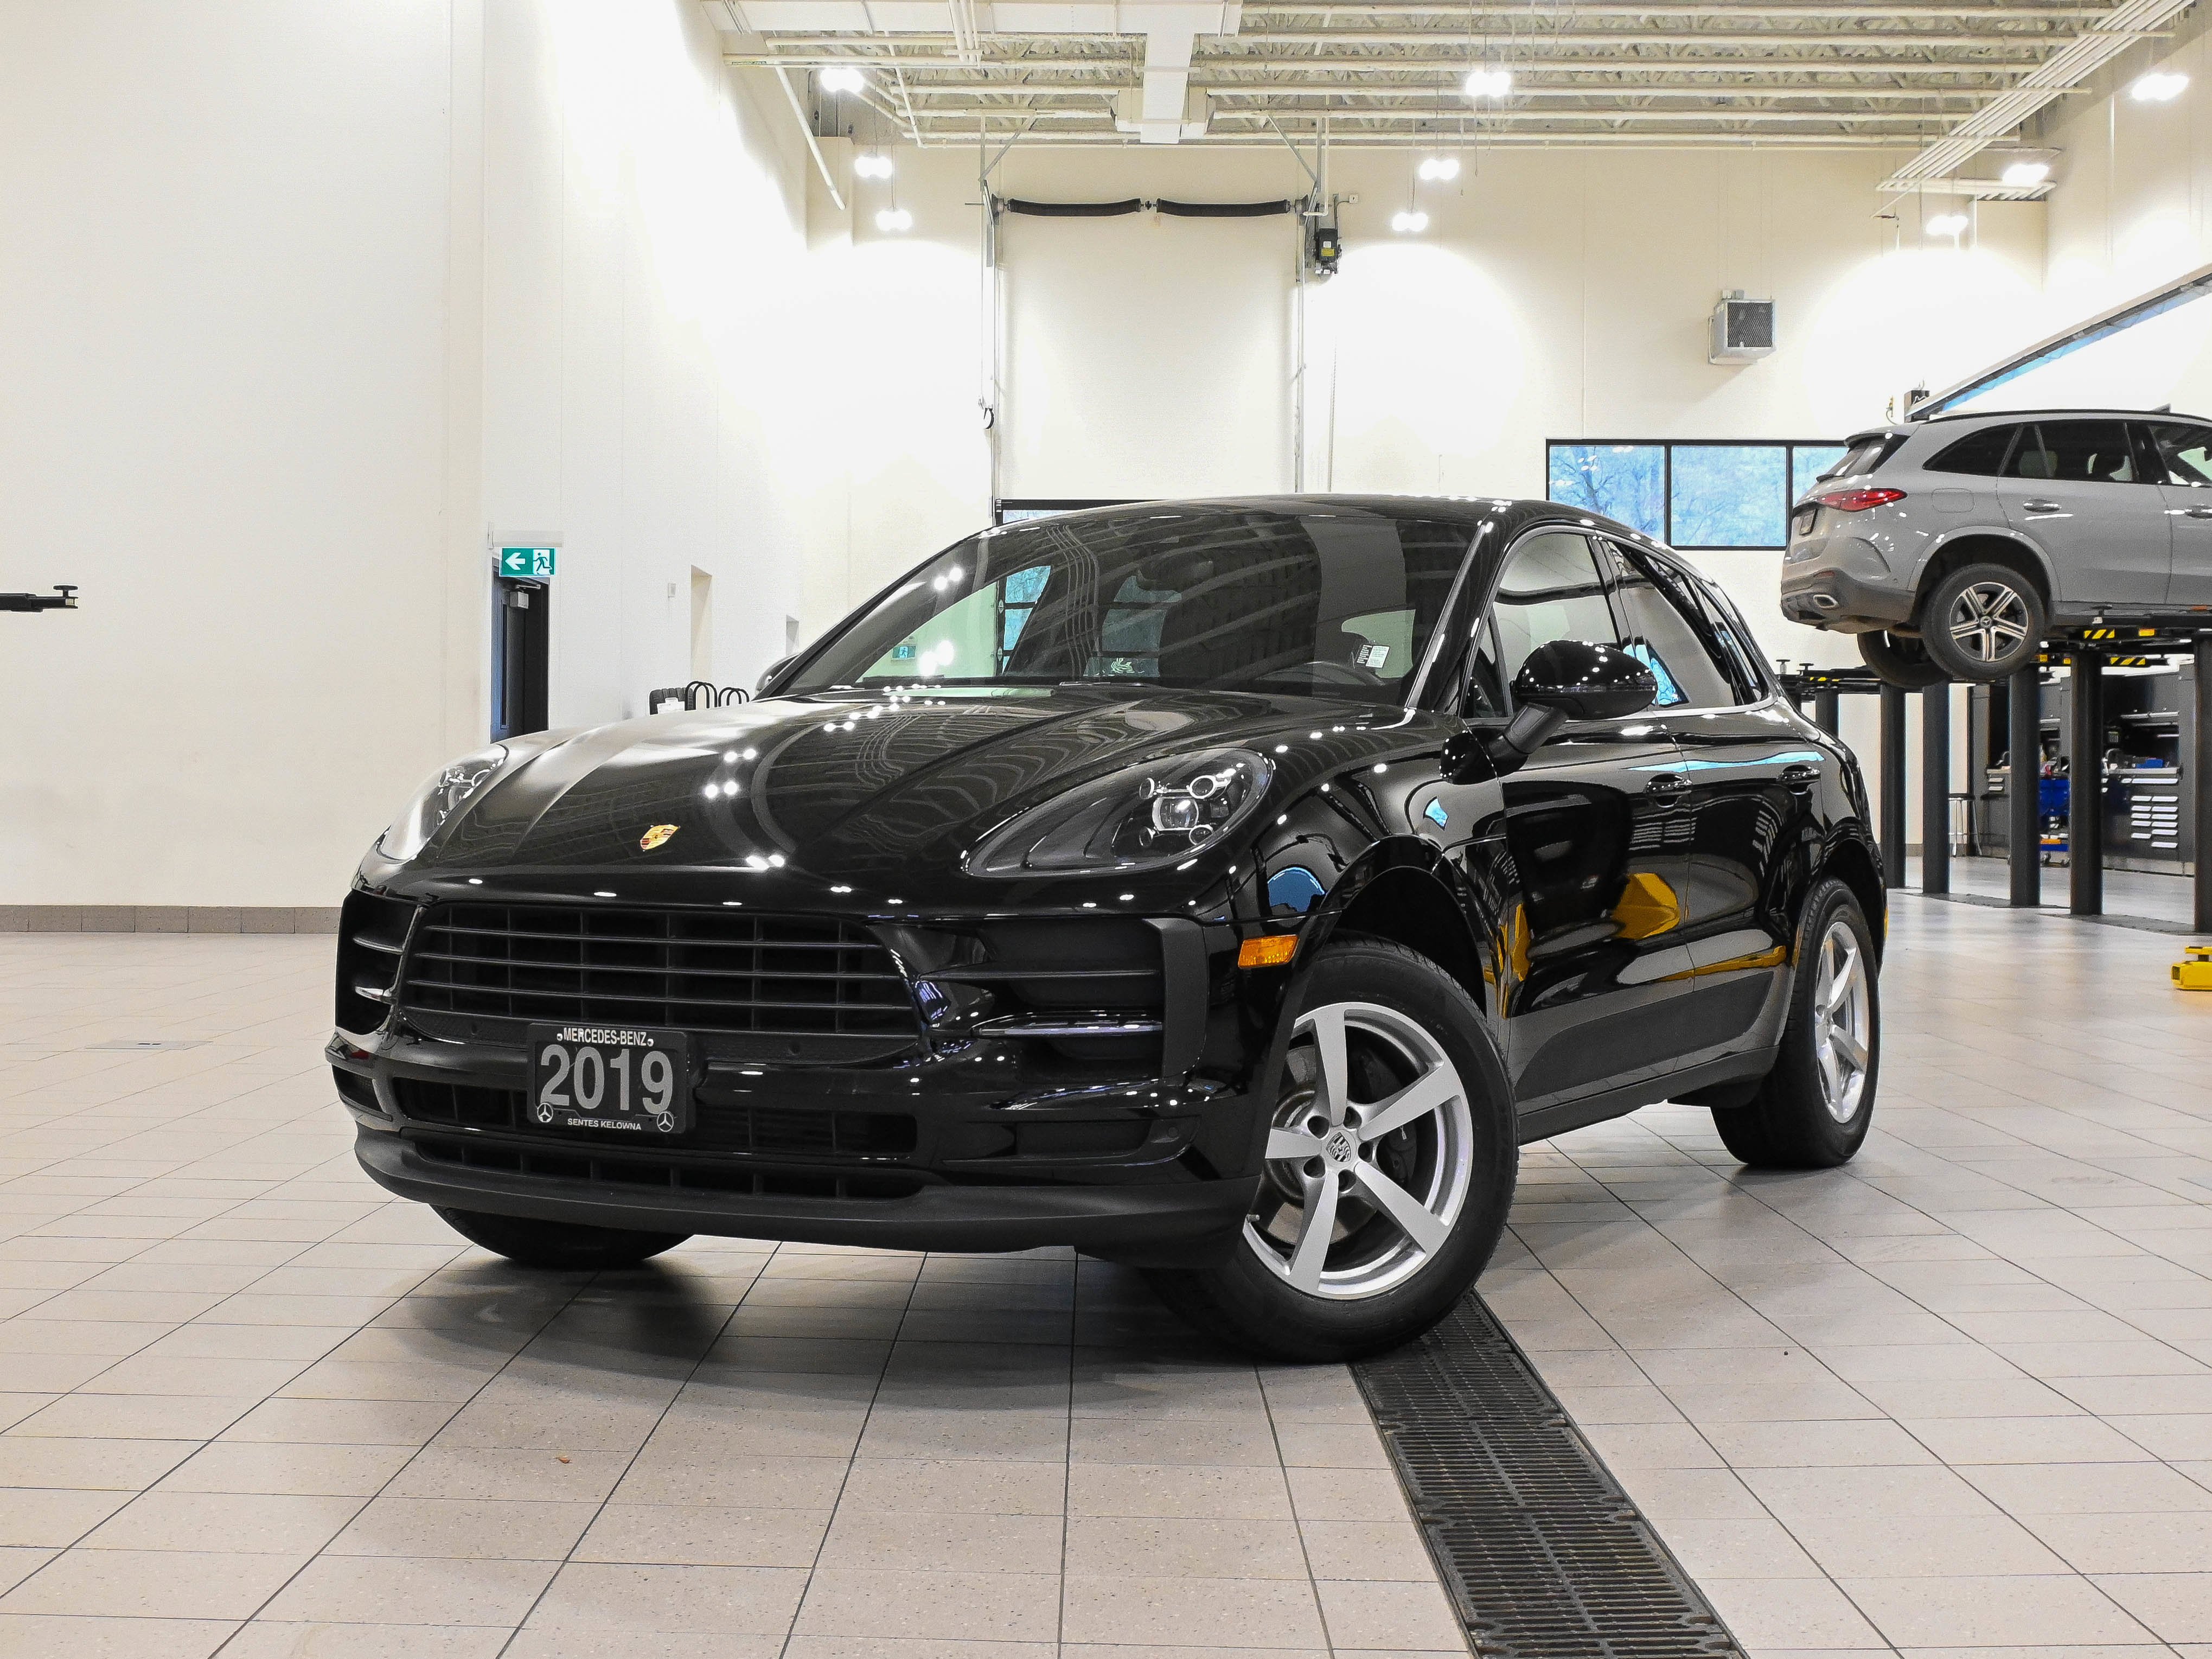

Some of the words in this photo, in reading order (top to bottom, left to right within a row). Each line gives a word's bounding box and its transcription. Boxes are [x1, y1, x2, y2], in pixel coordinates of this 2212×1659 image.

[564, 1028, 647, 1046] MERCEDES-BENZ
[540, 1044, 673, 1114] 2019
[567, 1118, 599, 1128] SENTES
[600, 1120, 641, 1131] KELOWNA
